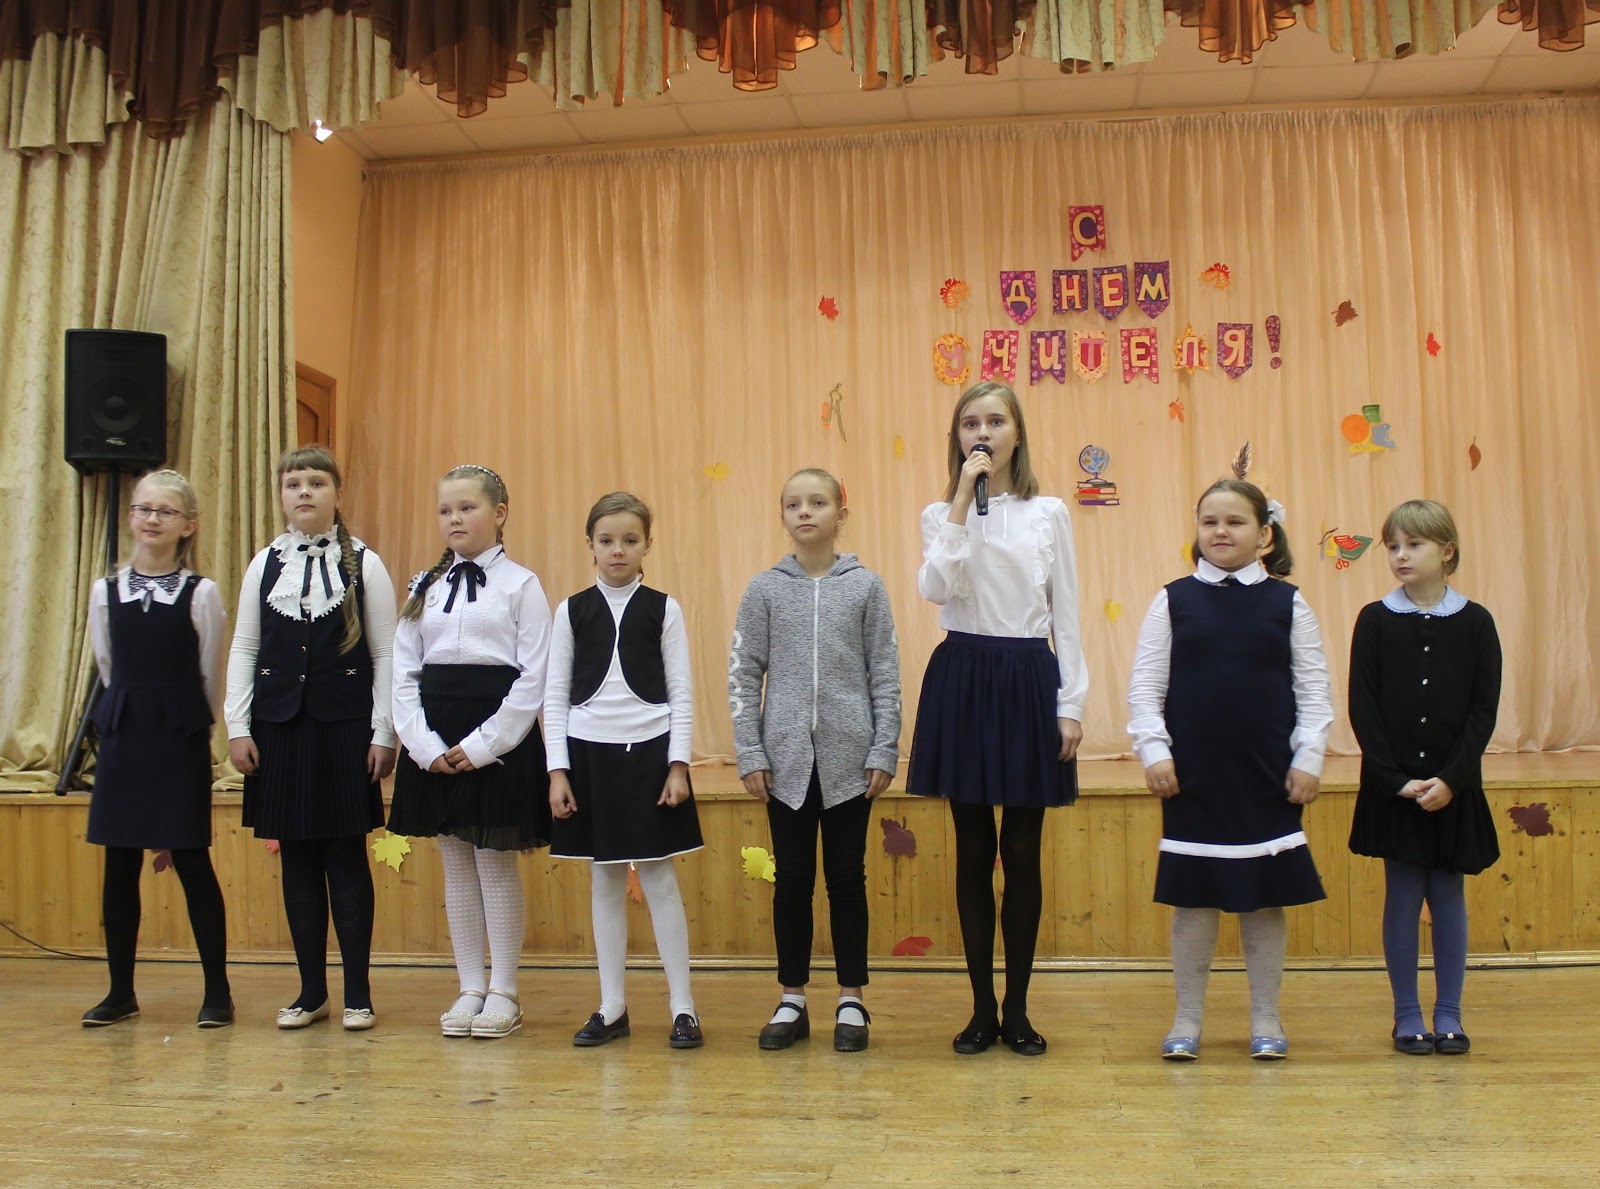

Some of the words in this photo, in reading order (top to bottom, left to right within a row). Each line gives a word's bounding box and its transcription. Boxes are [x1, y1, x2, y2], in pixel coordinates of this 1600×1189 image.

[1073, 211, 1098, 246] С
[1005, 272, 1168, 310] ДНЕМ
[937, 314, 1283, 379] УЧИТЕЛЯ!
